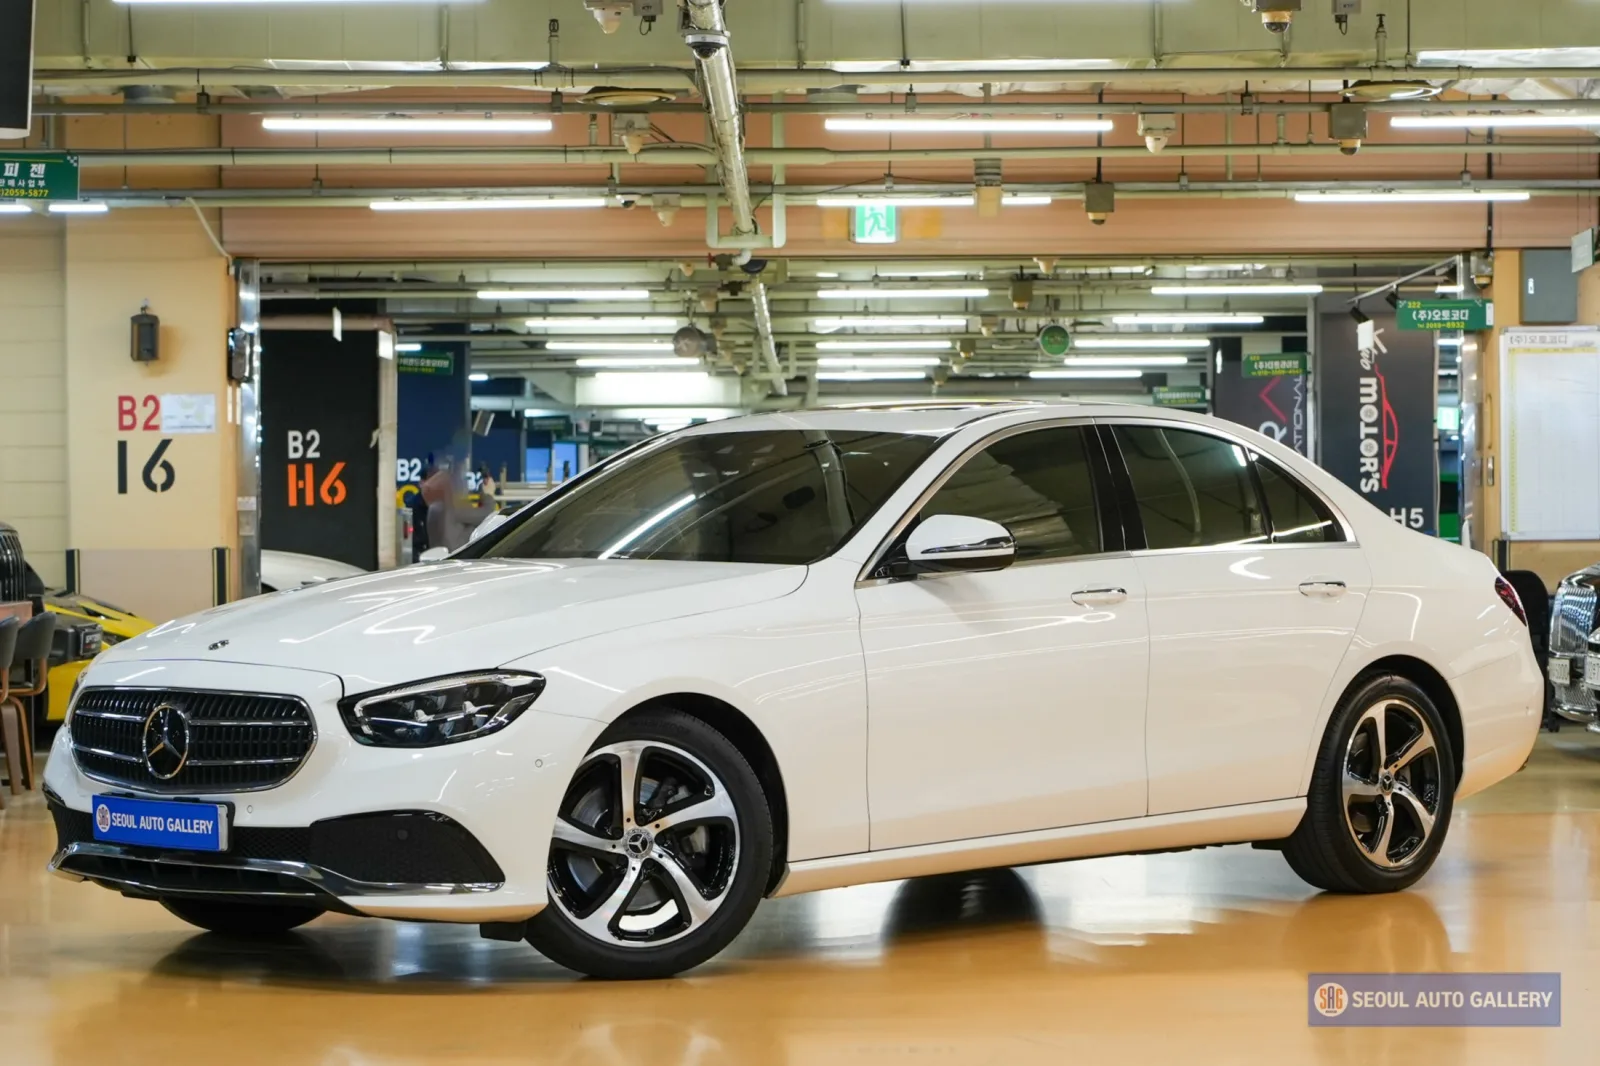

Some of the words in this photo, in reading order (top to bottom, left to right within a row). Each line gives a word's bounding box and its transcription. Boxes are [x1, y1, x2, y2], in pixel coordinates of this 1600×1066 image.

[0, 188, 49, 197] )2059-5877
[1412, 309, 1469, 321] (주)오토코디
[118, 394, 160, 431] B2
[287, 429, 321, 459] B2
[397, 457, 422, 482] B2
[287, 462, 347, 506] H6
[1390, 507, 1424, 529] H5
[112, 812, 137, 829] SEOUL
[139, 816, 164, 831] AUTO
[167, 819, 213, 834] GALLERY
